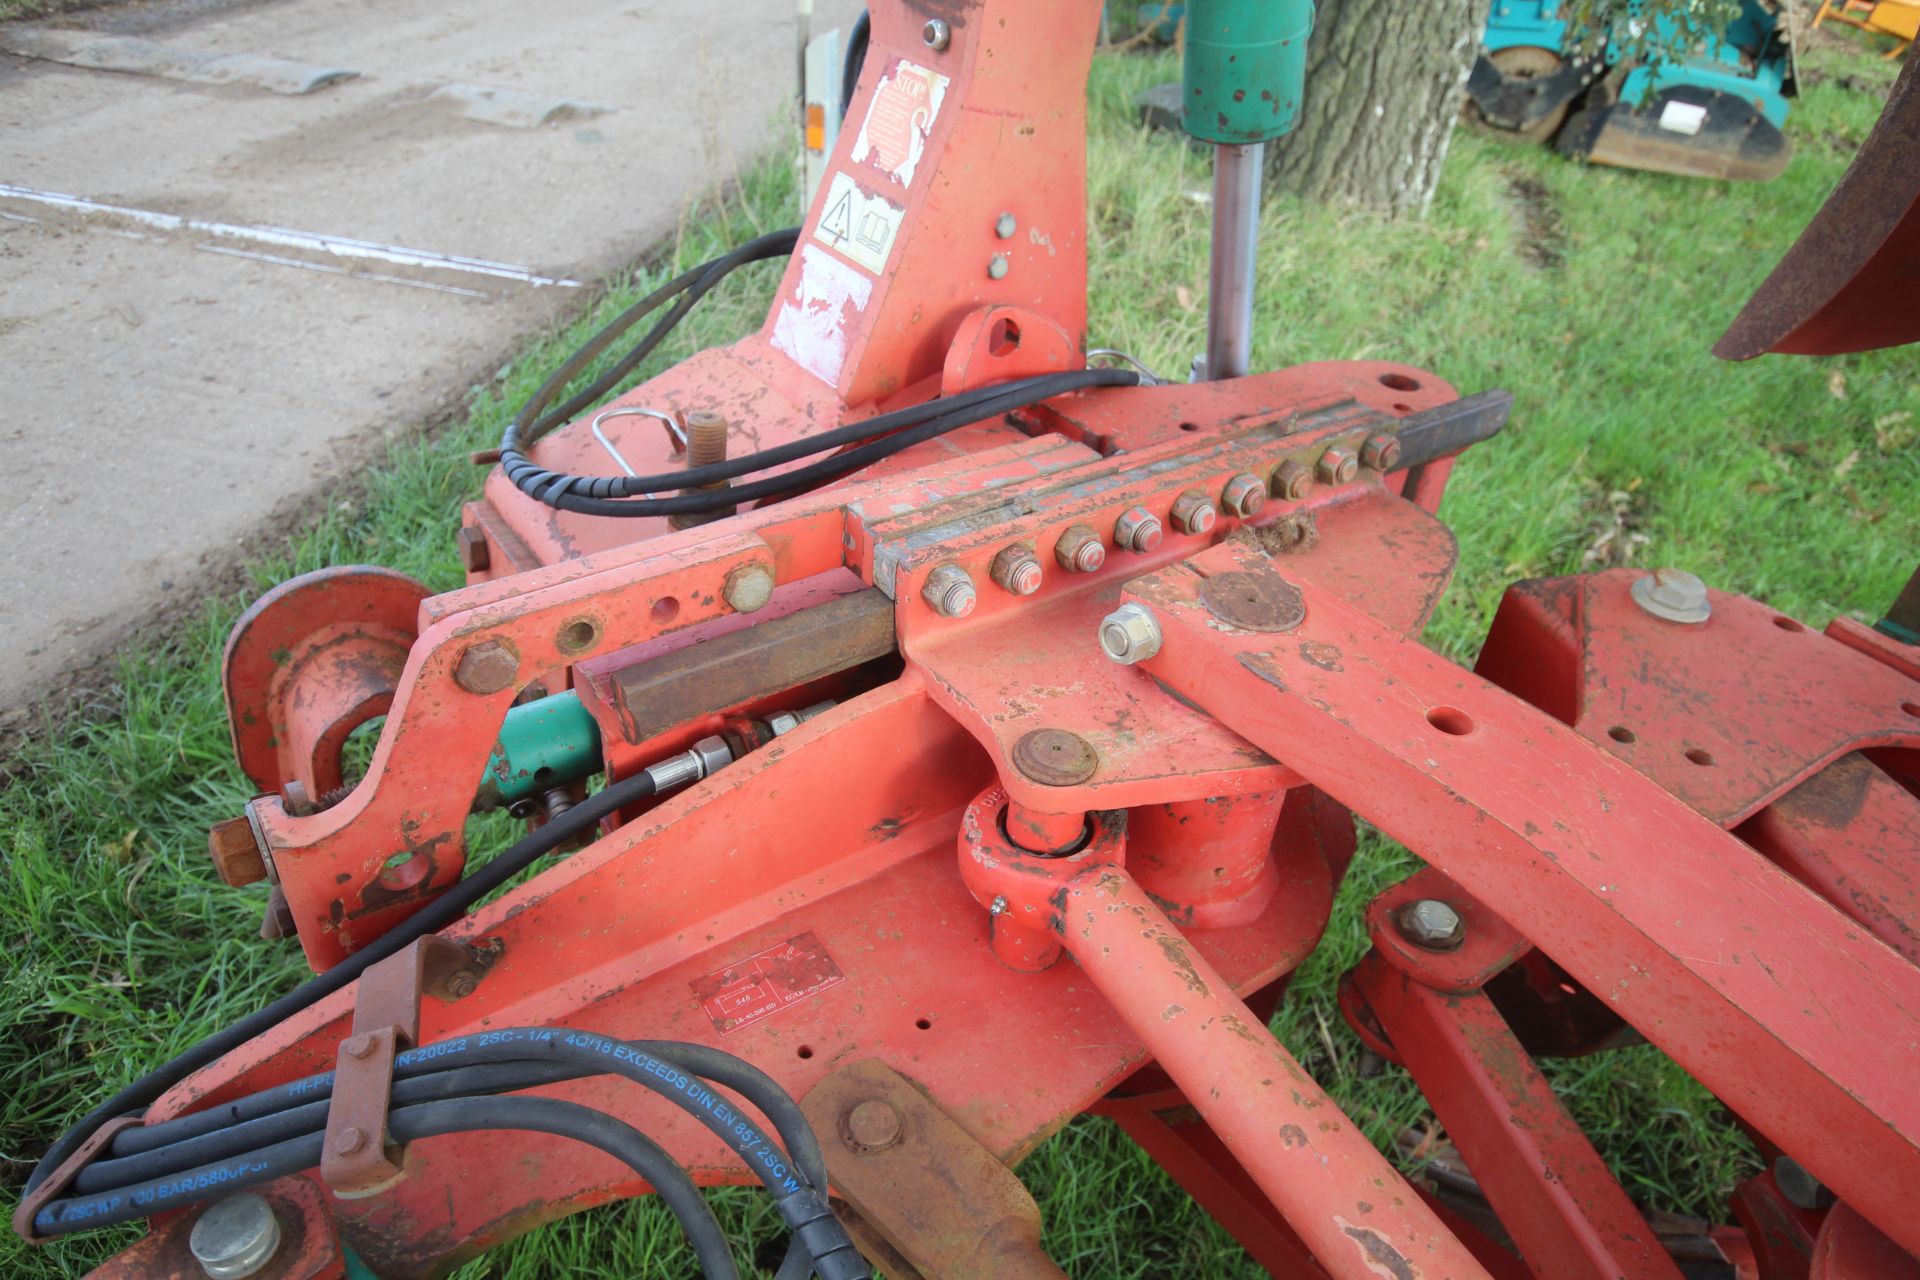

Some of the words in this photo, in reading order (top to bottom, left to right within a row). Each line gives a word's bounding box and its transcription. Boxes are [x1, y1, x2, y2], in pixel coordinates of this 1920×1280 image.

[479, 1031, 513, 1047] 2SC
[613, 1046, 688, 1089] EXCEEDS
[687, 1083, 716, 1110] DIN
[713, 1104, 737, 1127] EN
[735, 1122, 762, 1147] 857
[757, 1146, 786, 1178] 2SC
[783, 1176, 800, 1193] W
